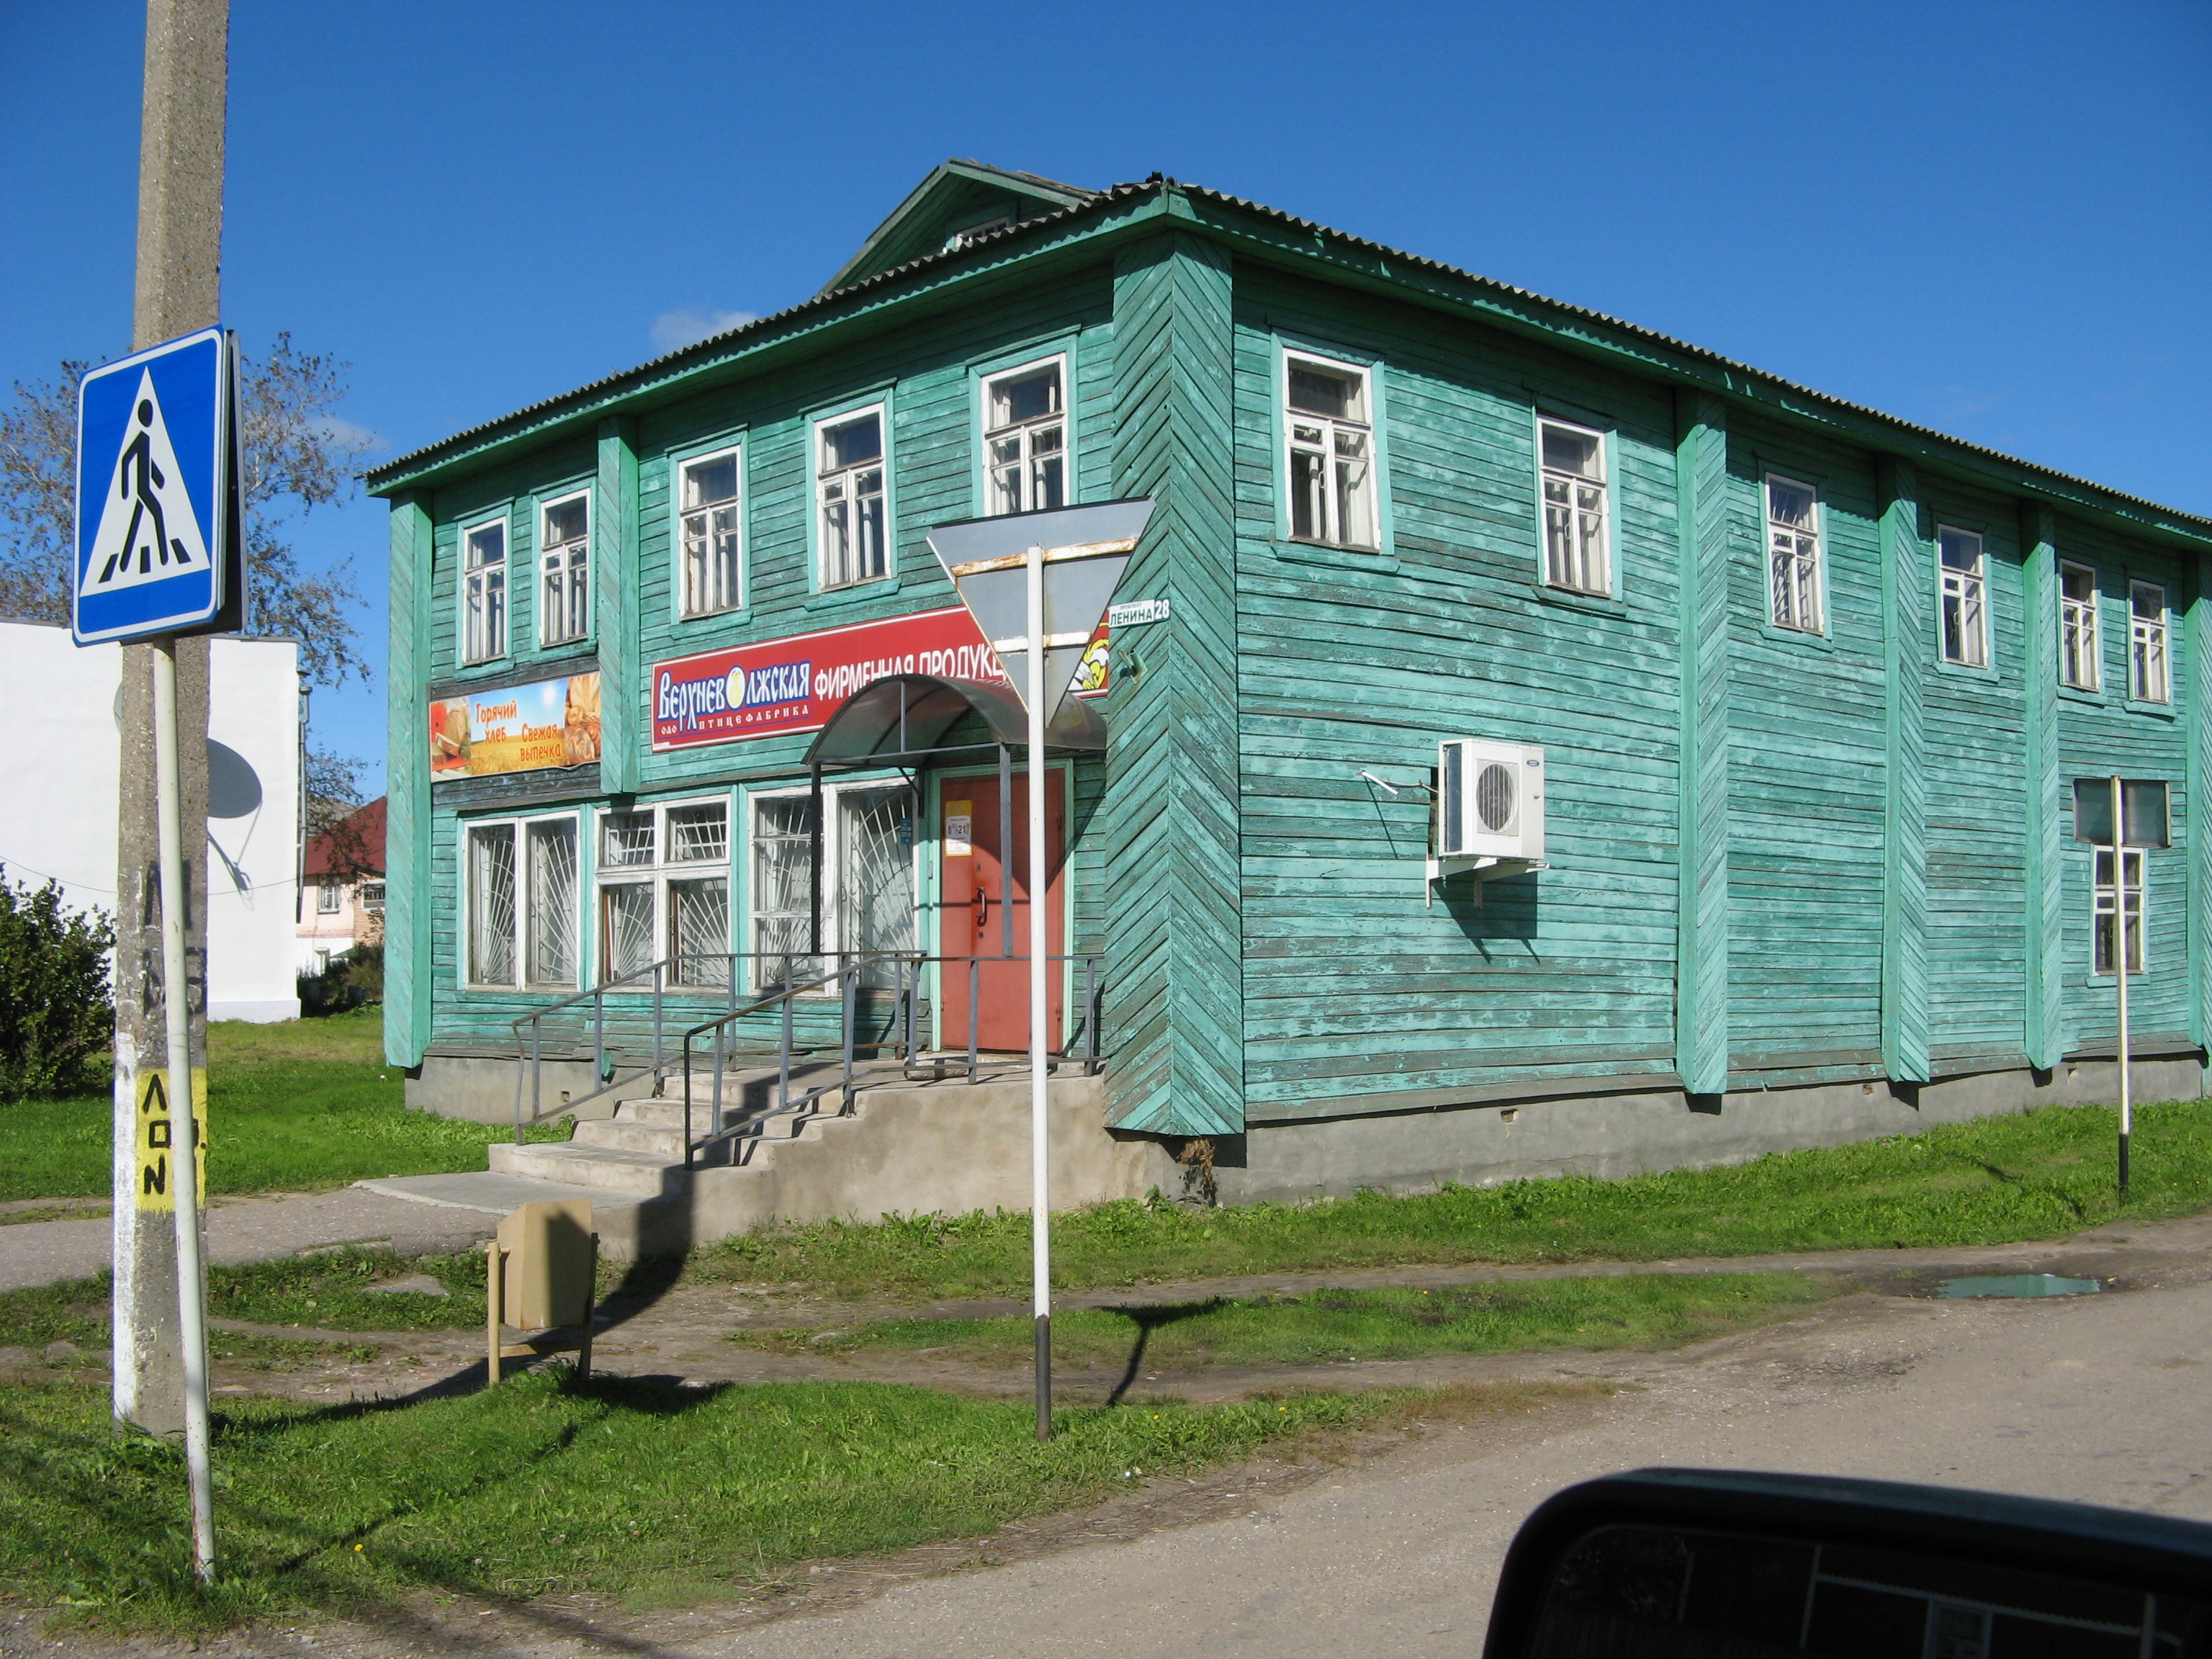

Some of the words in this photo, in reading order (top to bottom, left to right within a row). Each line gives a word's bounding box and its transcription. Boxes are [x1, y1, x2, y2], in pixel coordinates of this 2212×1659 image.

[1110, 608, 1152, 626] ЛЕНИНА
[1154, 599, 1170, 620] 28
[476, 699, 517, 729] Горячий
[660, 724, 678, 735] ОАО
[698, 705, 809, 731] ПТИЦЕФАБРИКА
[485, 727, 507, 745] хлеб
[521, 723, 558, 743] Свежая
[520, 743, 562, 762] выпечка
